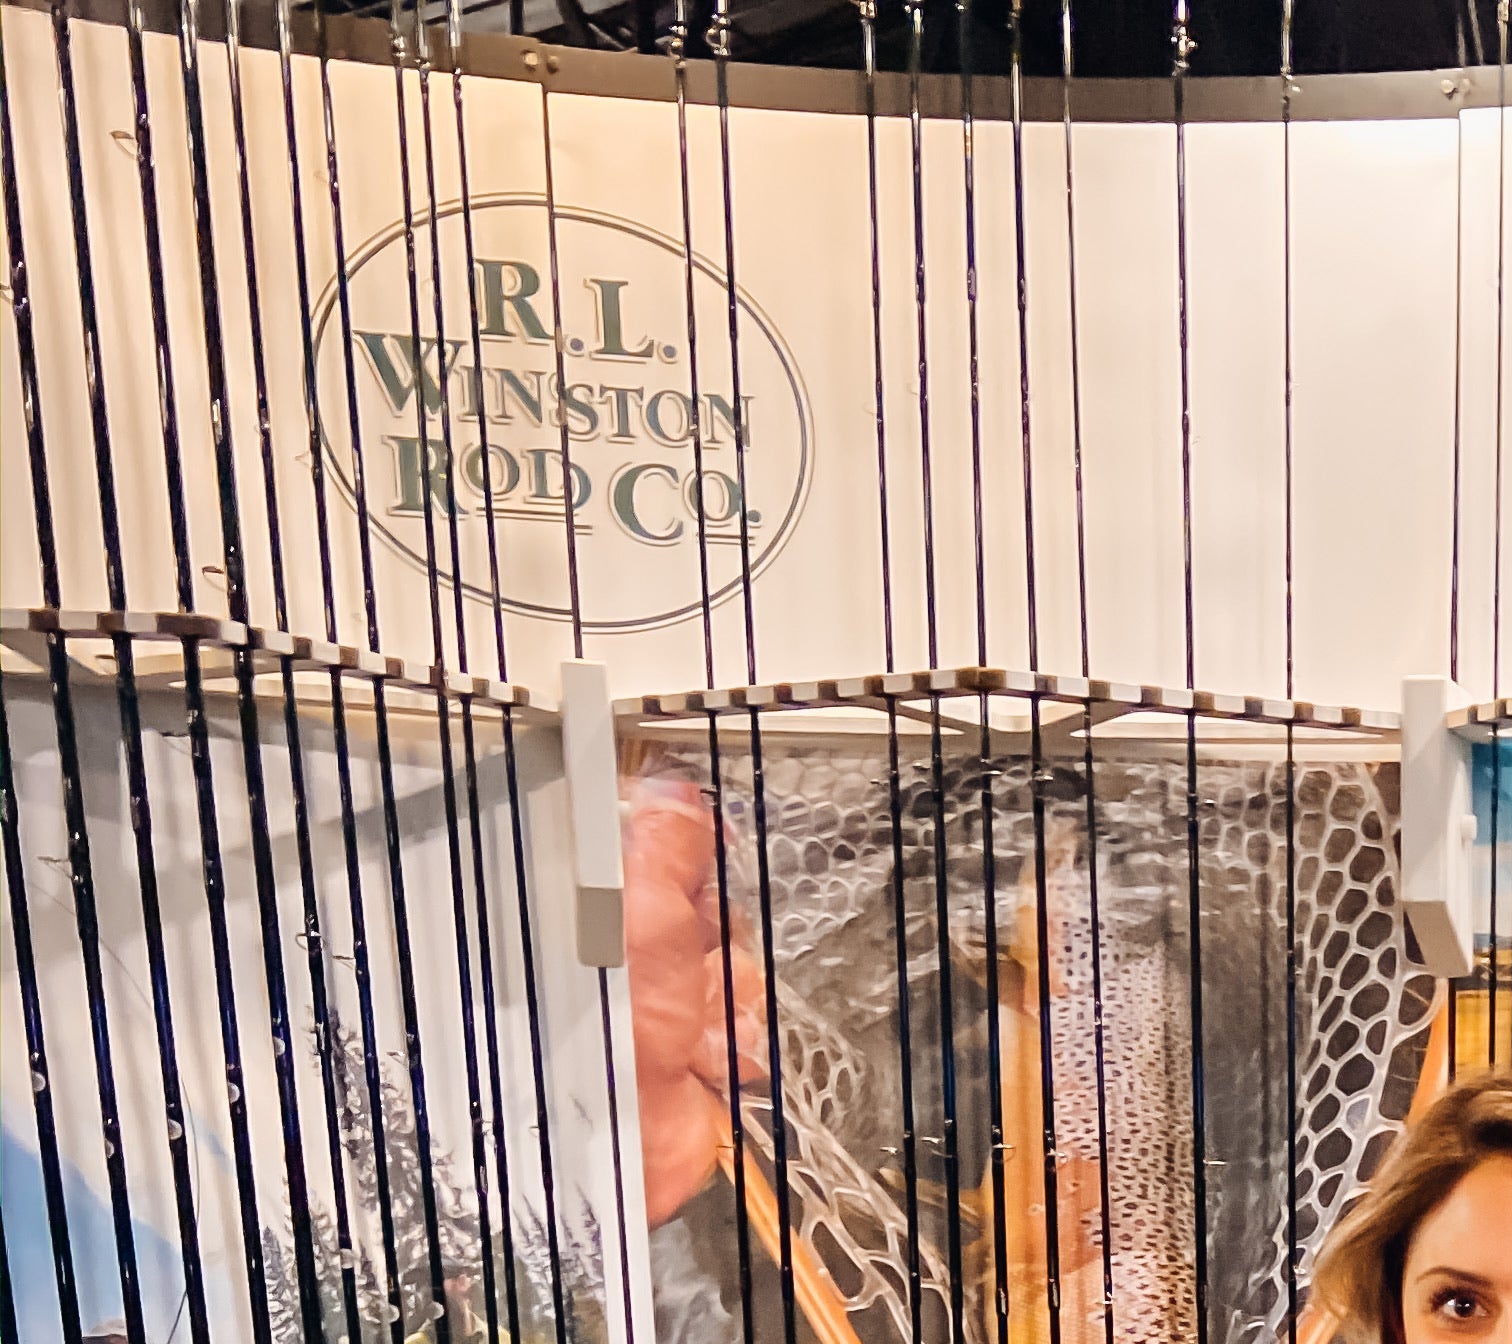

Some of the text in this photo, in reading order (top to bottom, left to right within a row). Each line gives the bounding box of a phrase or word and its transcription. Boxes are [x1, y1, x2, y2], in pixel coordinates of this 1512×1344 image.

[475, 257, 679, 361] R.L.
[354, 330, 755, 449] WINSTON
[386, 434, 763, 544] ROD CO.
